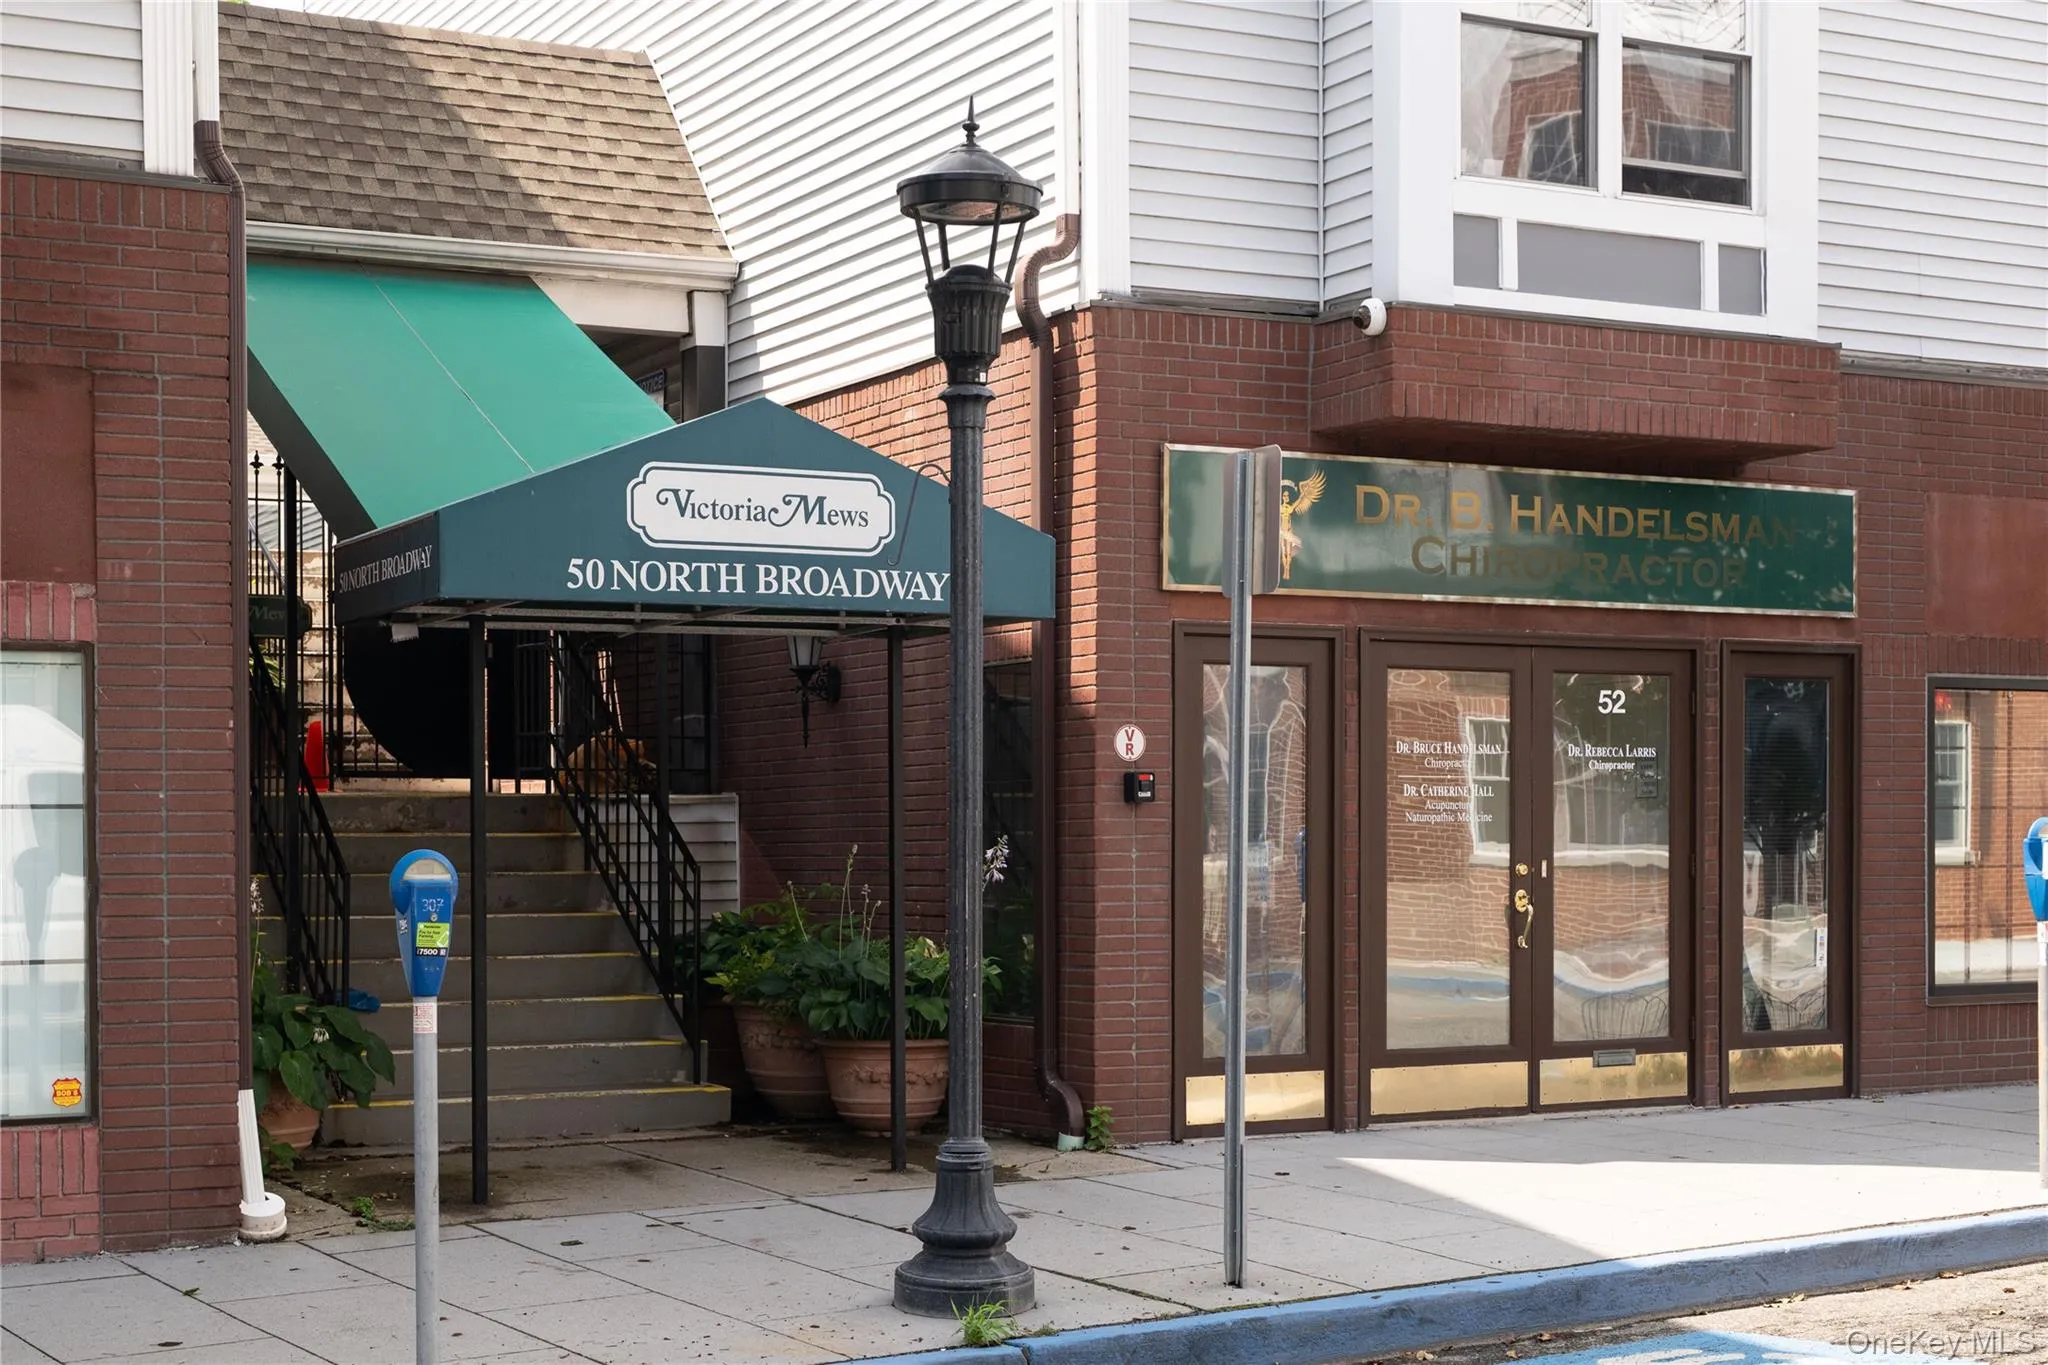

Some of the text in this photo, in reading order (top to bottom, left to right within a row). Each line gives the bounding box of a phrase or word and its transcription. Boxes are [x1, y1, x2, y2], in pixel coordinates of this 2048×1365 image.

[656, 487, 869, 527] Victoria Mews
[1355, 485, 1797, 547] DR. B. HANDELSMAN
[339, 544, 433, 593] 50 NORTH BROADWAY
[1411, 535, 1748, 589] CHIROPRACTOR
[567, 558, 951, 602] 50 NORTH BROADWAY
[1598, 689, 1626, 714] 52
[1124, 729, 1135, 742] V
[1125, 743, 1134, 756] R
[1413, 741, 1442, 754] BRUCE
[1585, 743, 1624, 758] REBECCA
[1626, 744, 1656, 758] LARRIS
[1425, 758, 1472, 769] Chiropract
[1589, 759, 1635, 772] Chiropractor
[1420, 784, 1468, 797] CATHERINE
[1470, 784, 1494, 797] HALL
[1425, 799, 1473, 811] Acupunctur
[1405, 812, 1493, 824] Naturopathic Mecine
